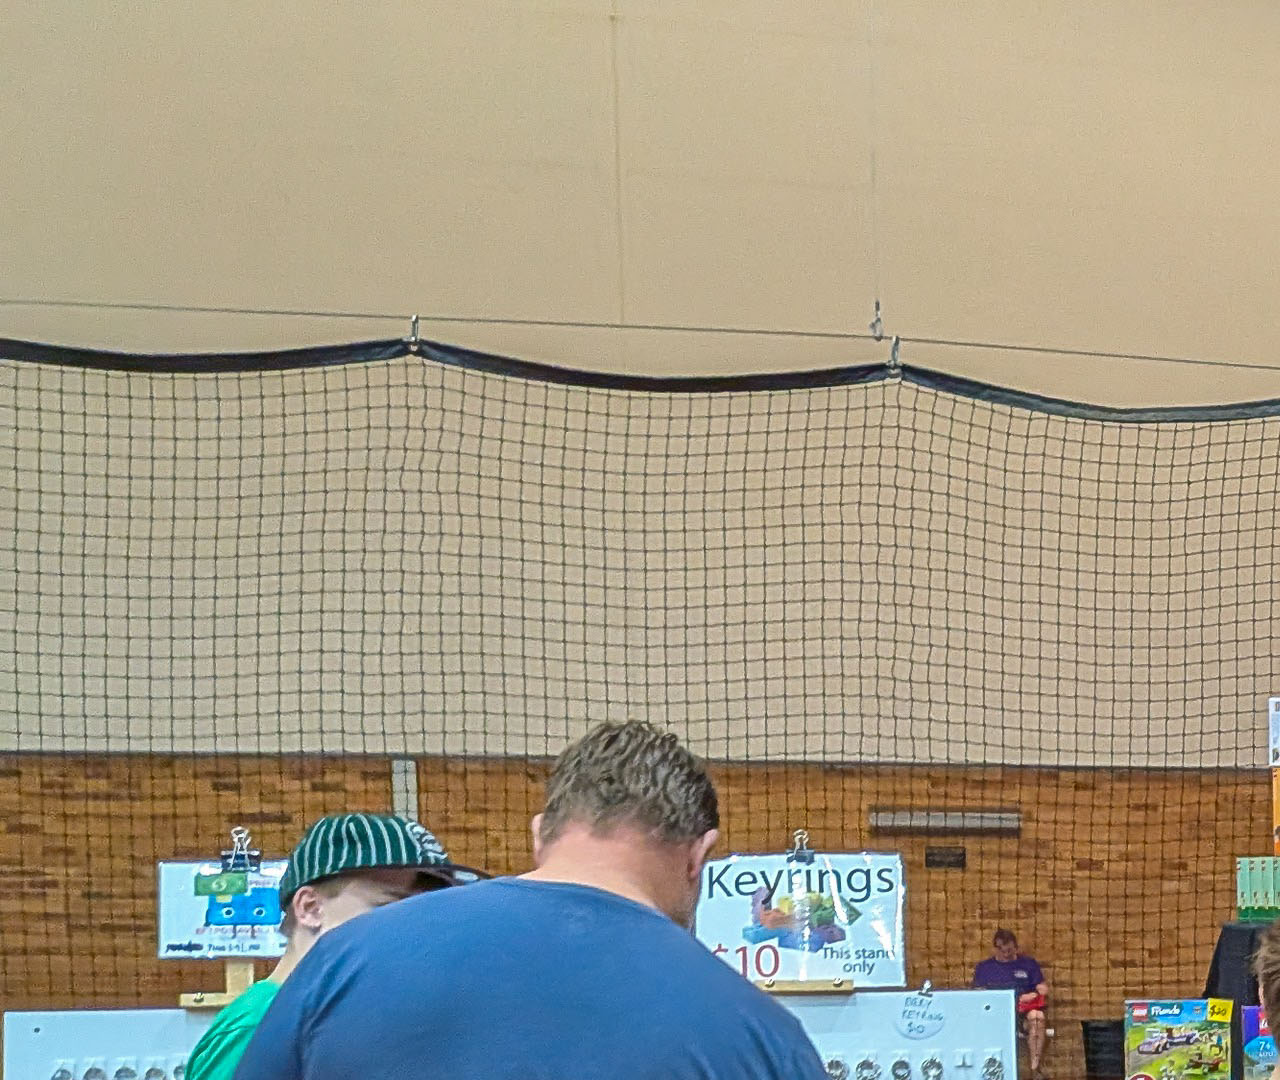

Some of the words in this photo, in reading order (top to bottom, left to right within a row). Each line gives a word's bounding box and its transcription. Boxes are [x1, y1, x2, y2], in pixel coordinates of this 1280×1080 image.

[707, 863, 895, 904] Keyrings
[823, 947, 851, 960] This
[842, 959, 876, 976] only
